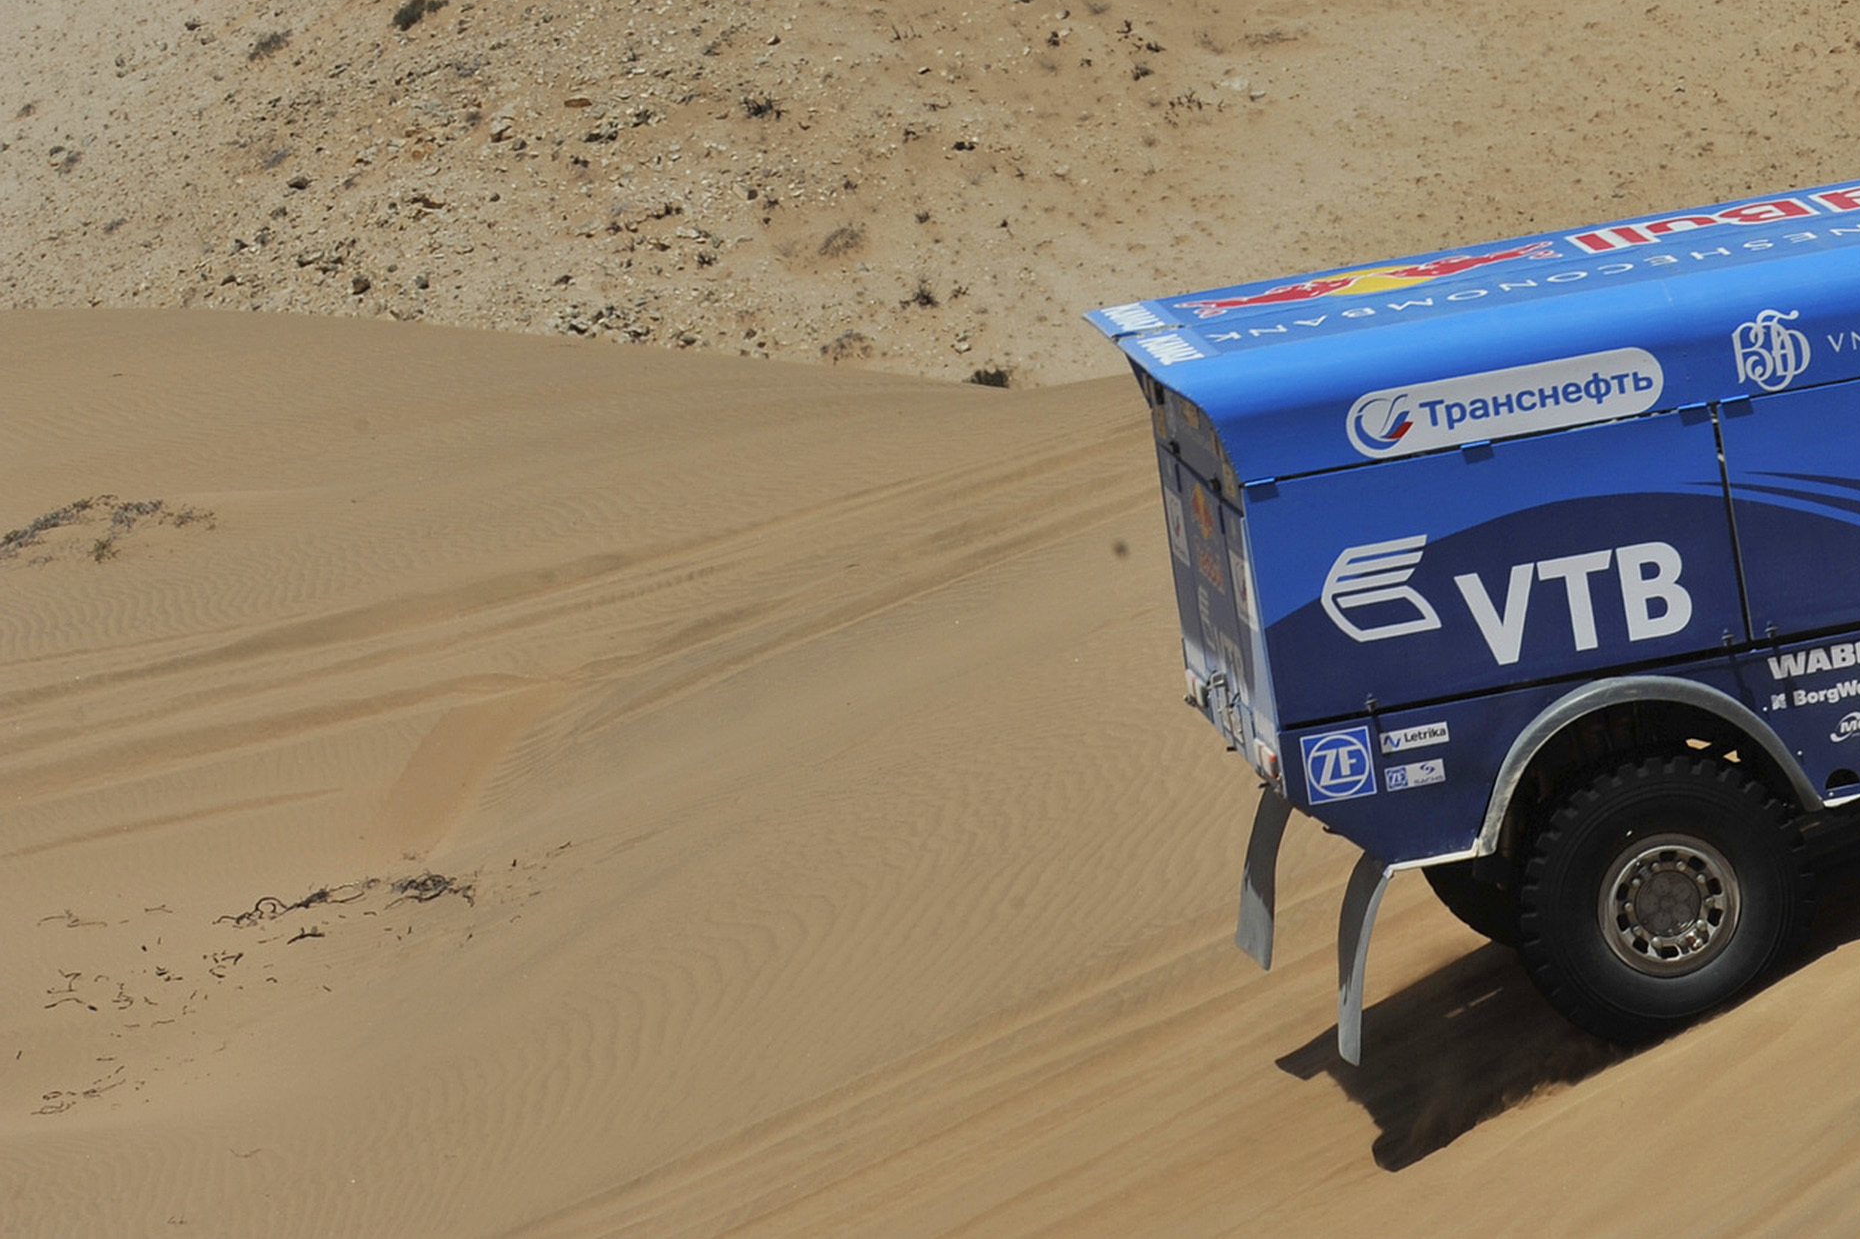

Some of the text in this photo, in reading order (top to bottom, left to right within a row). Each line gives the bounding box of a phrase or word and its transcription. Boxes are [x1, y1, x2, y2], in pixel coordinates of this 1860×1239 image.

[1564, 197, 1820, 254] Bull
[1419, 371, 1654, 430] Транснефть
[1454, 541, 1693, 665] VTB
[1404, 727, 1447, 743] Letrika
[1310, 745, 1365, 787] ZF
